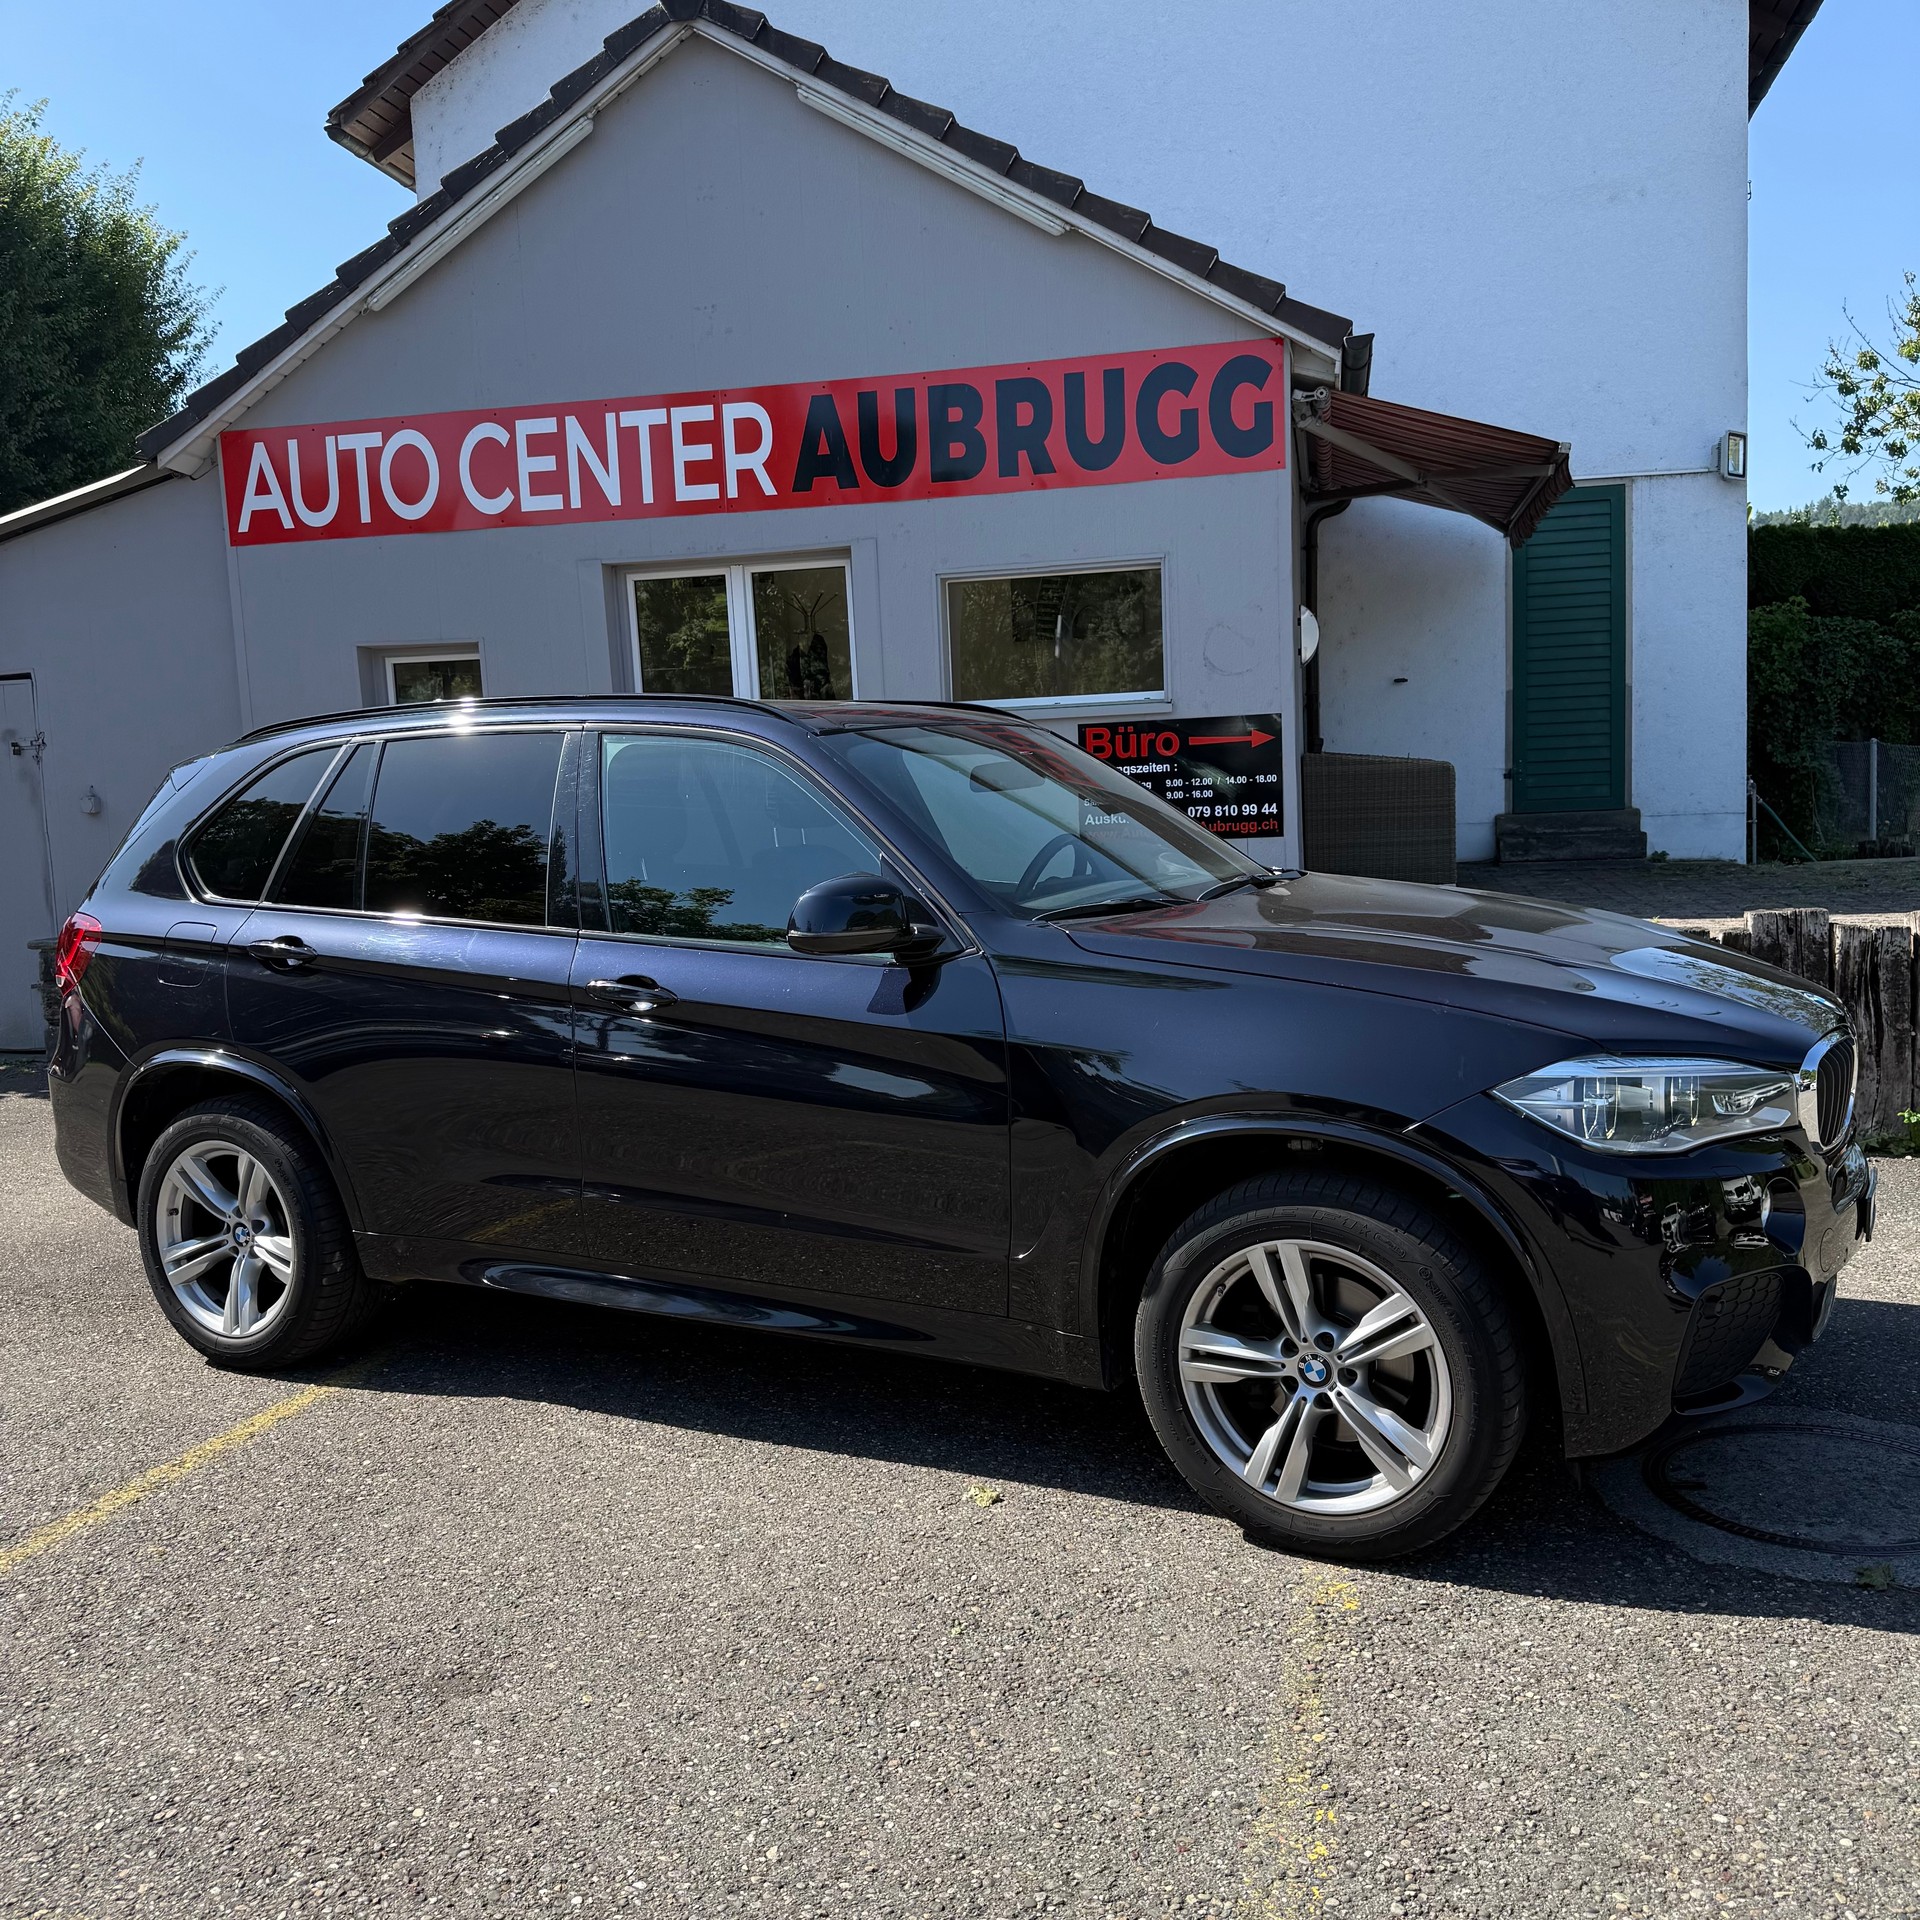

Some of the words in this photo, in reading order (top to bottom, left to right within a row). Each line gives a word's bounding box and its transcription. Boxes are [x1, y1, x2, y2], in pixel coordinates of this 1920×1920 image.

[238, 429, 440, 533] AUTO
[459, 402, 778, 515] CENTER
[791, 354, 1274, 493] AUBRUGG
[1085, 726, 1180, 760] Büro
[1165, 778, 1183, 788] 9.00
[1190, 777, 1213, 787] 12.00
[1224, 775, 1248, 785] 14.00
[1255, 774, 1278, 784] 18.00
[1166, 790, 1184, 800] 9.00
[1191, 789, 1214, 799] 16.00
[1187, 805, 1211, 819] 079
[1214, 804, 1238, 817] 810
[1241, 803, 1258, 816] 99
[1261, 802, 1279, 815] 44
